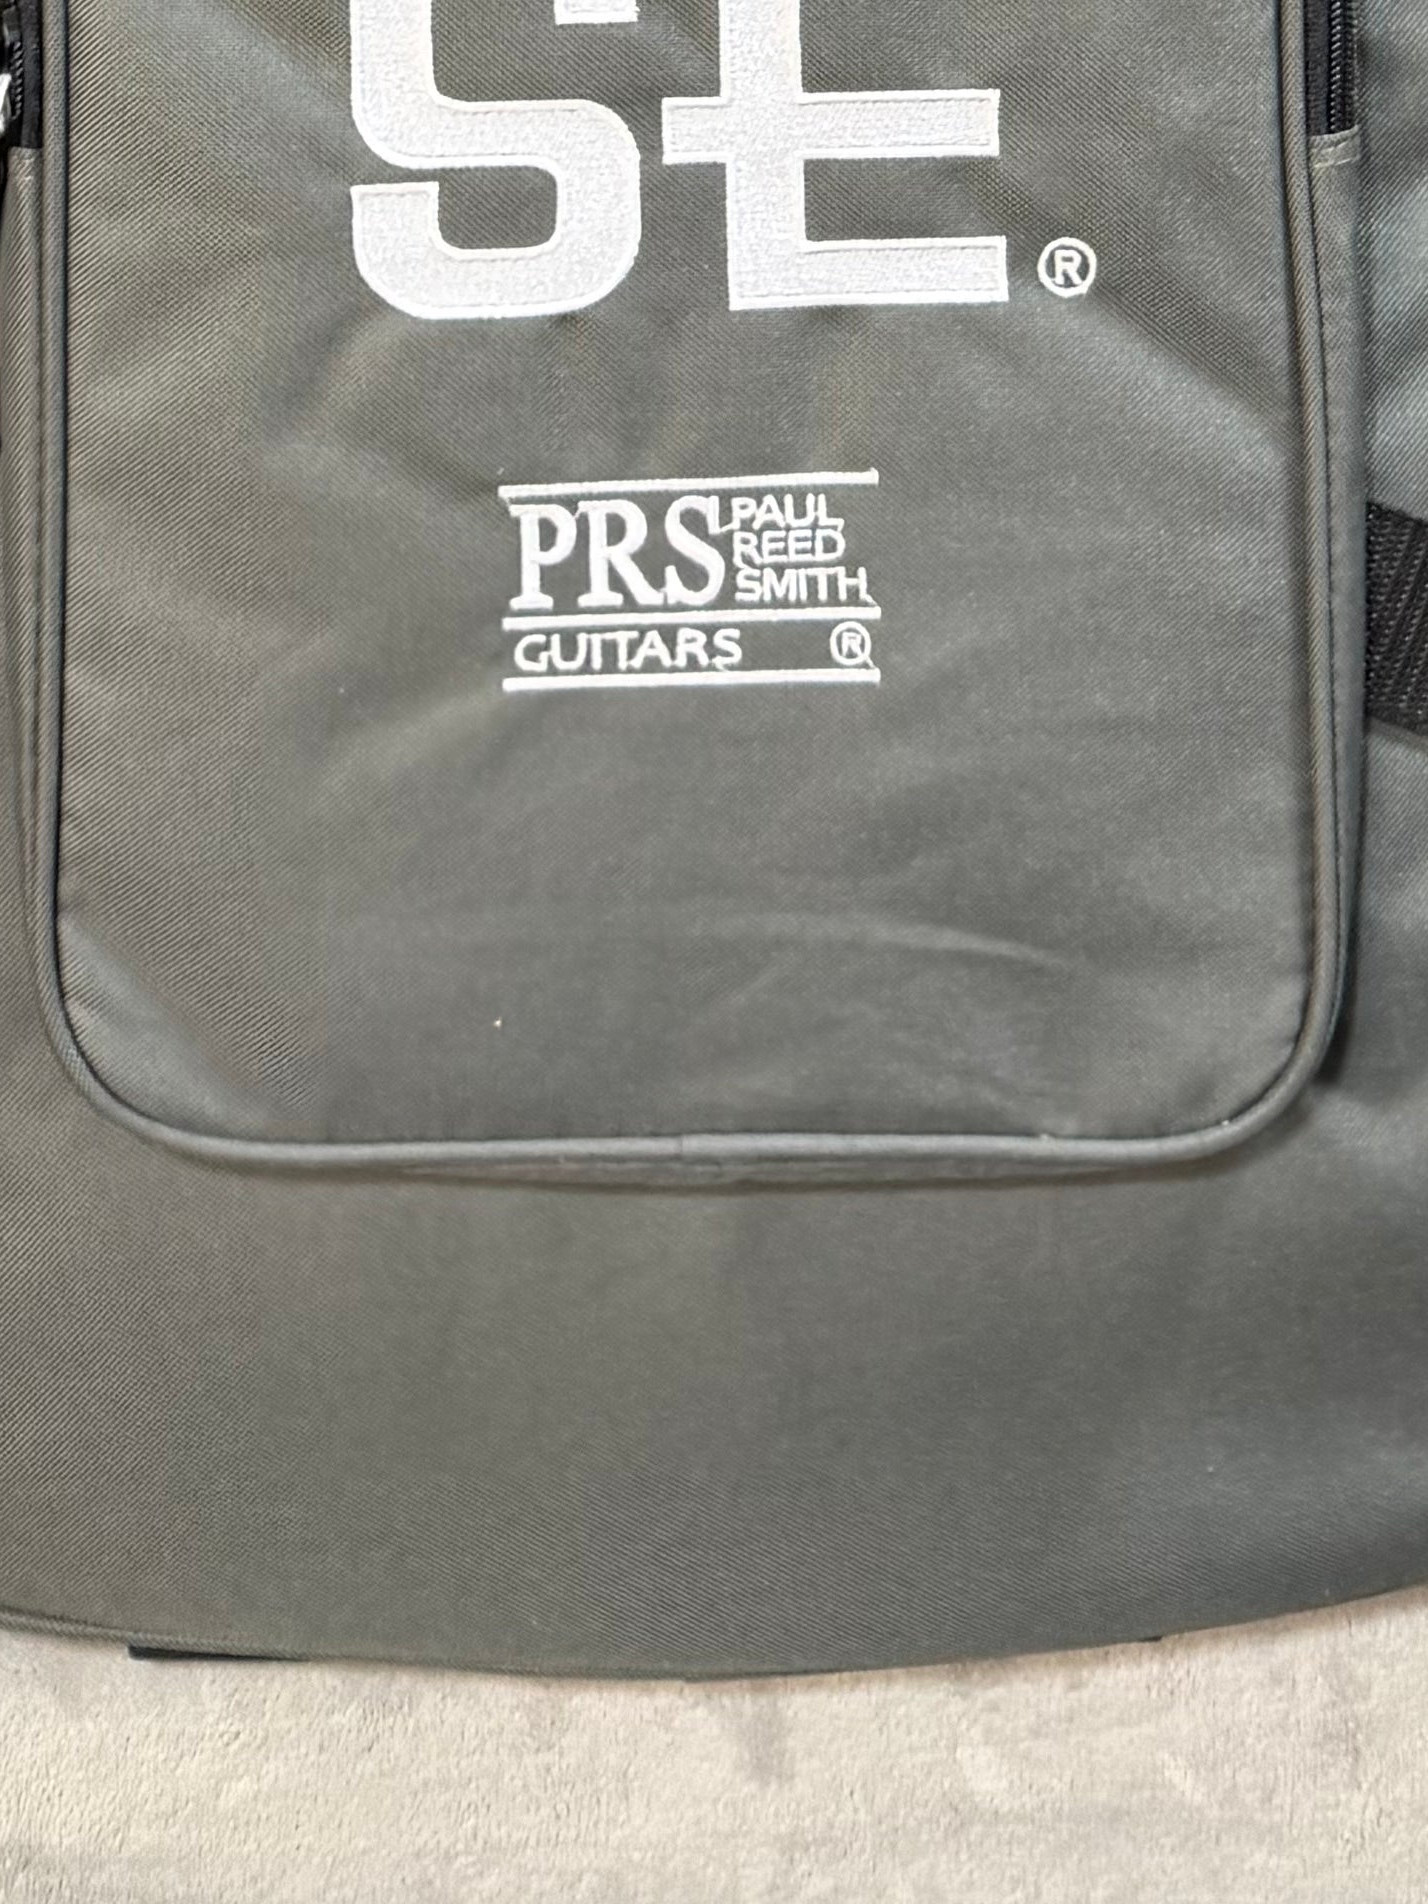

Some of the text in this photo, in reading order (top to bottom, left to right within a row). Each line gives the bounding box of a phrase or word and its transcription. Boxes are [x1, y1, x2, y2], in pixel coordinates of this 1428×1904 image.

[731, 493, 845, 530] PAUL
[508, 495, 726, 610] PRS
[732, 528, 846, 566] REED
[735, 565, 870, 604] SMITH
[513, 627, 743, 673] GUITARS
